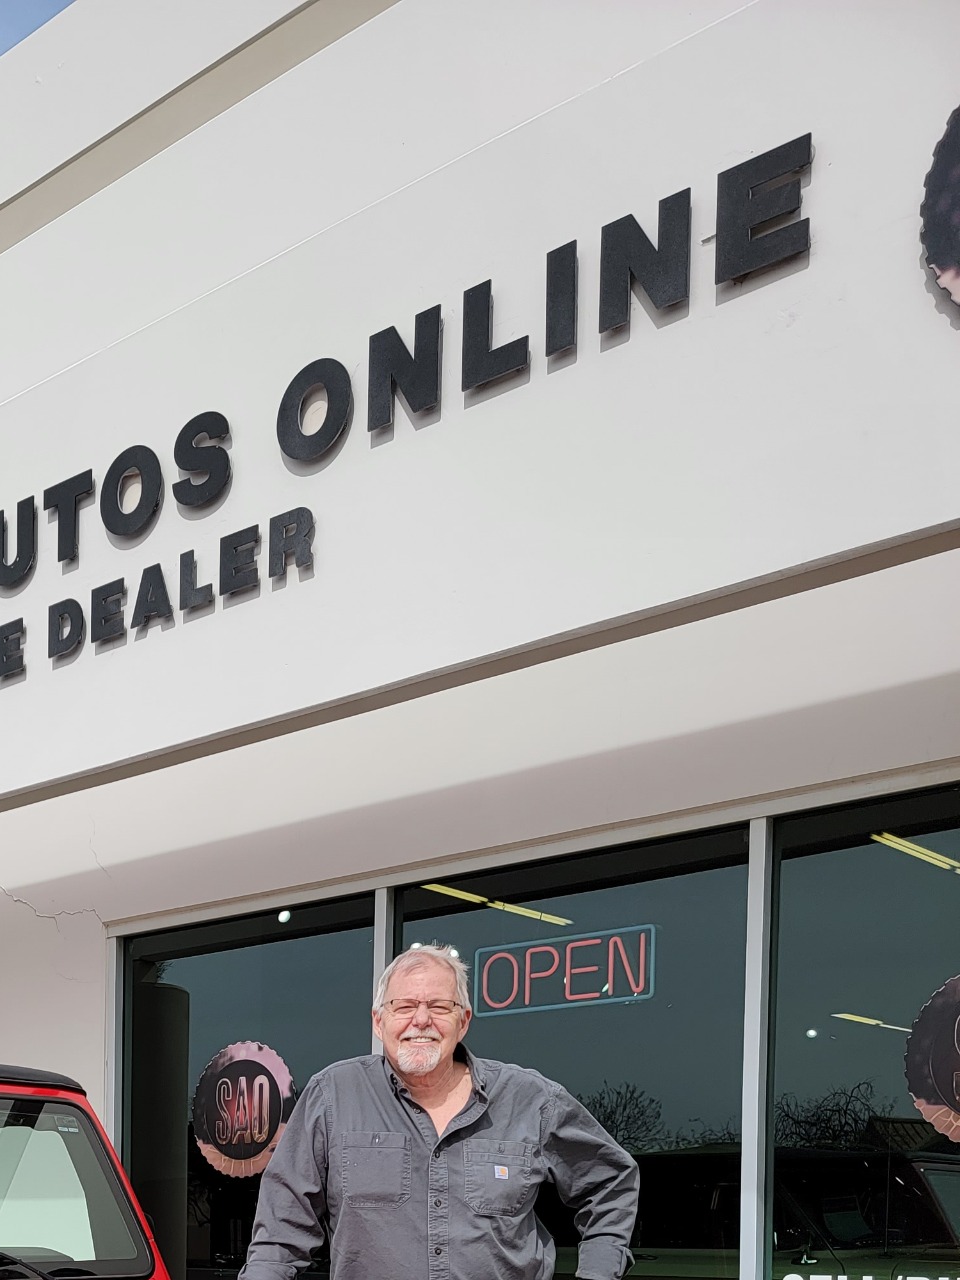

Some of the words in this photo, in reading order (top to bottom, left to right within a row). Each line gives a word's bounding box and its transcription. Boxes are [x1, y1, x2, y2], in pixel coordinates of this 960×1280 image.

[276, 132, 813, 462] ONLINE
[48, 506, 316, 659] DEALER
[482, 932, 646, 1009] OPEN
[215, 1074, 270, 1145] SAO
